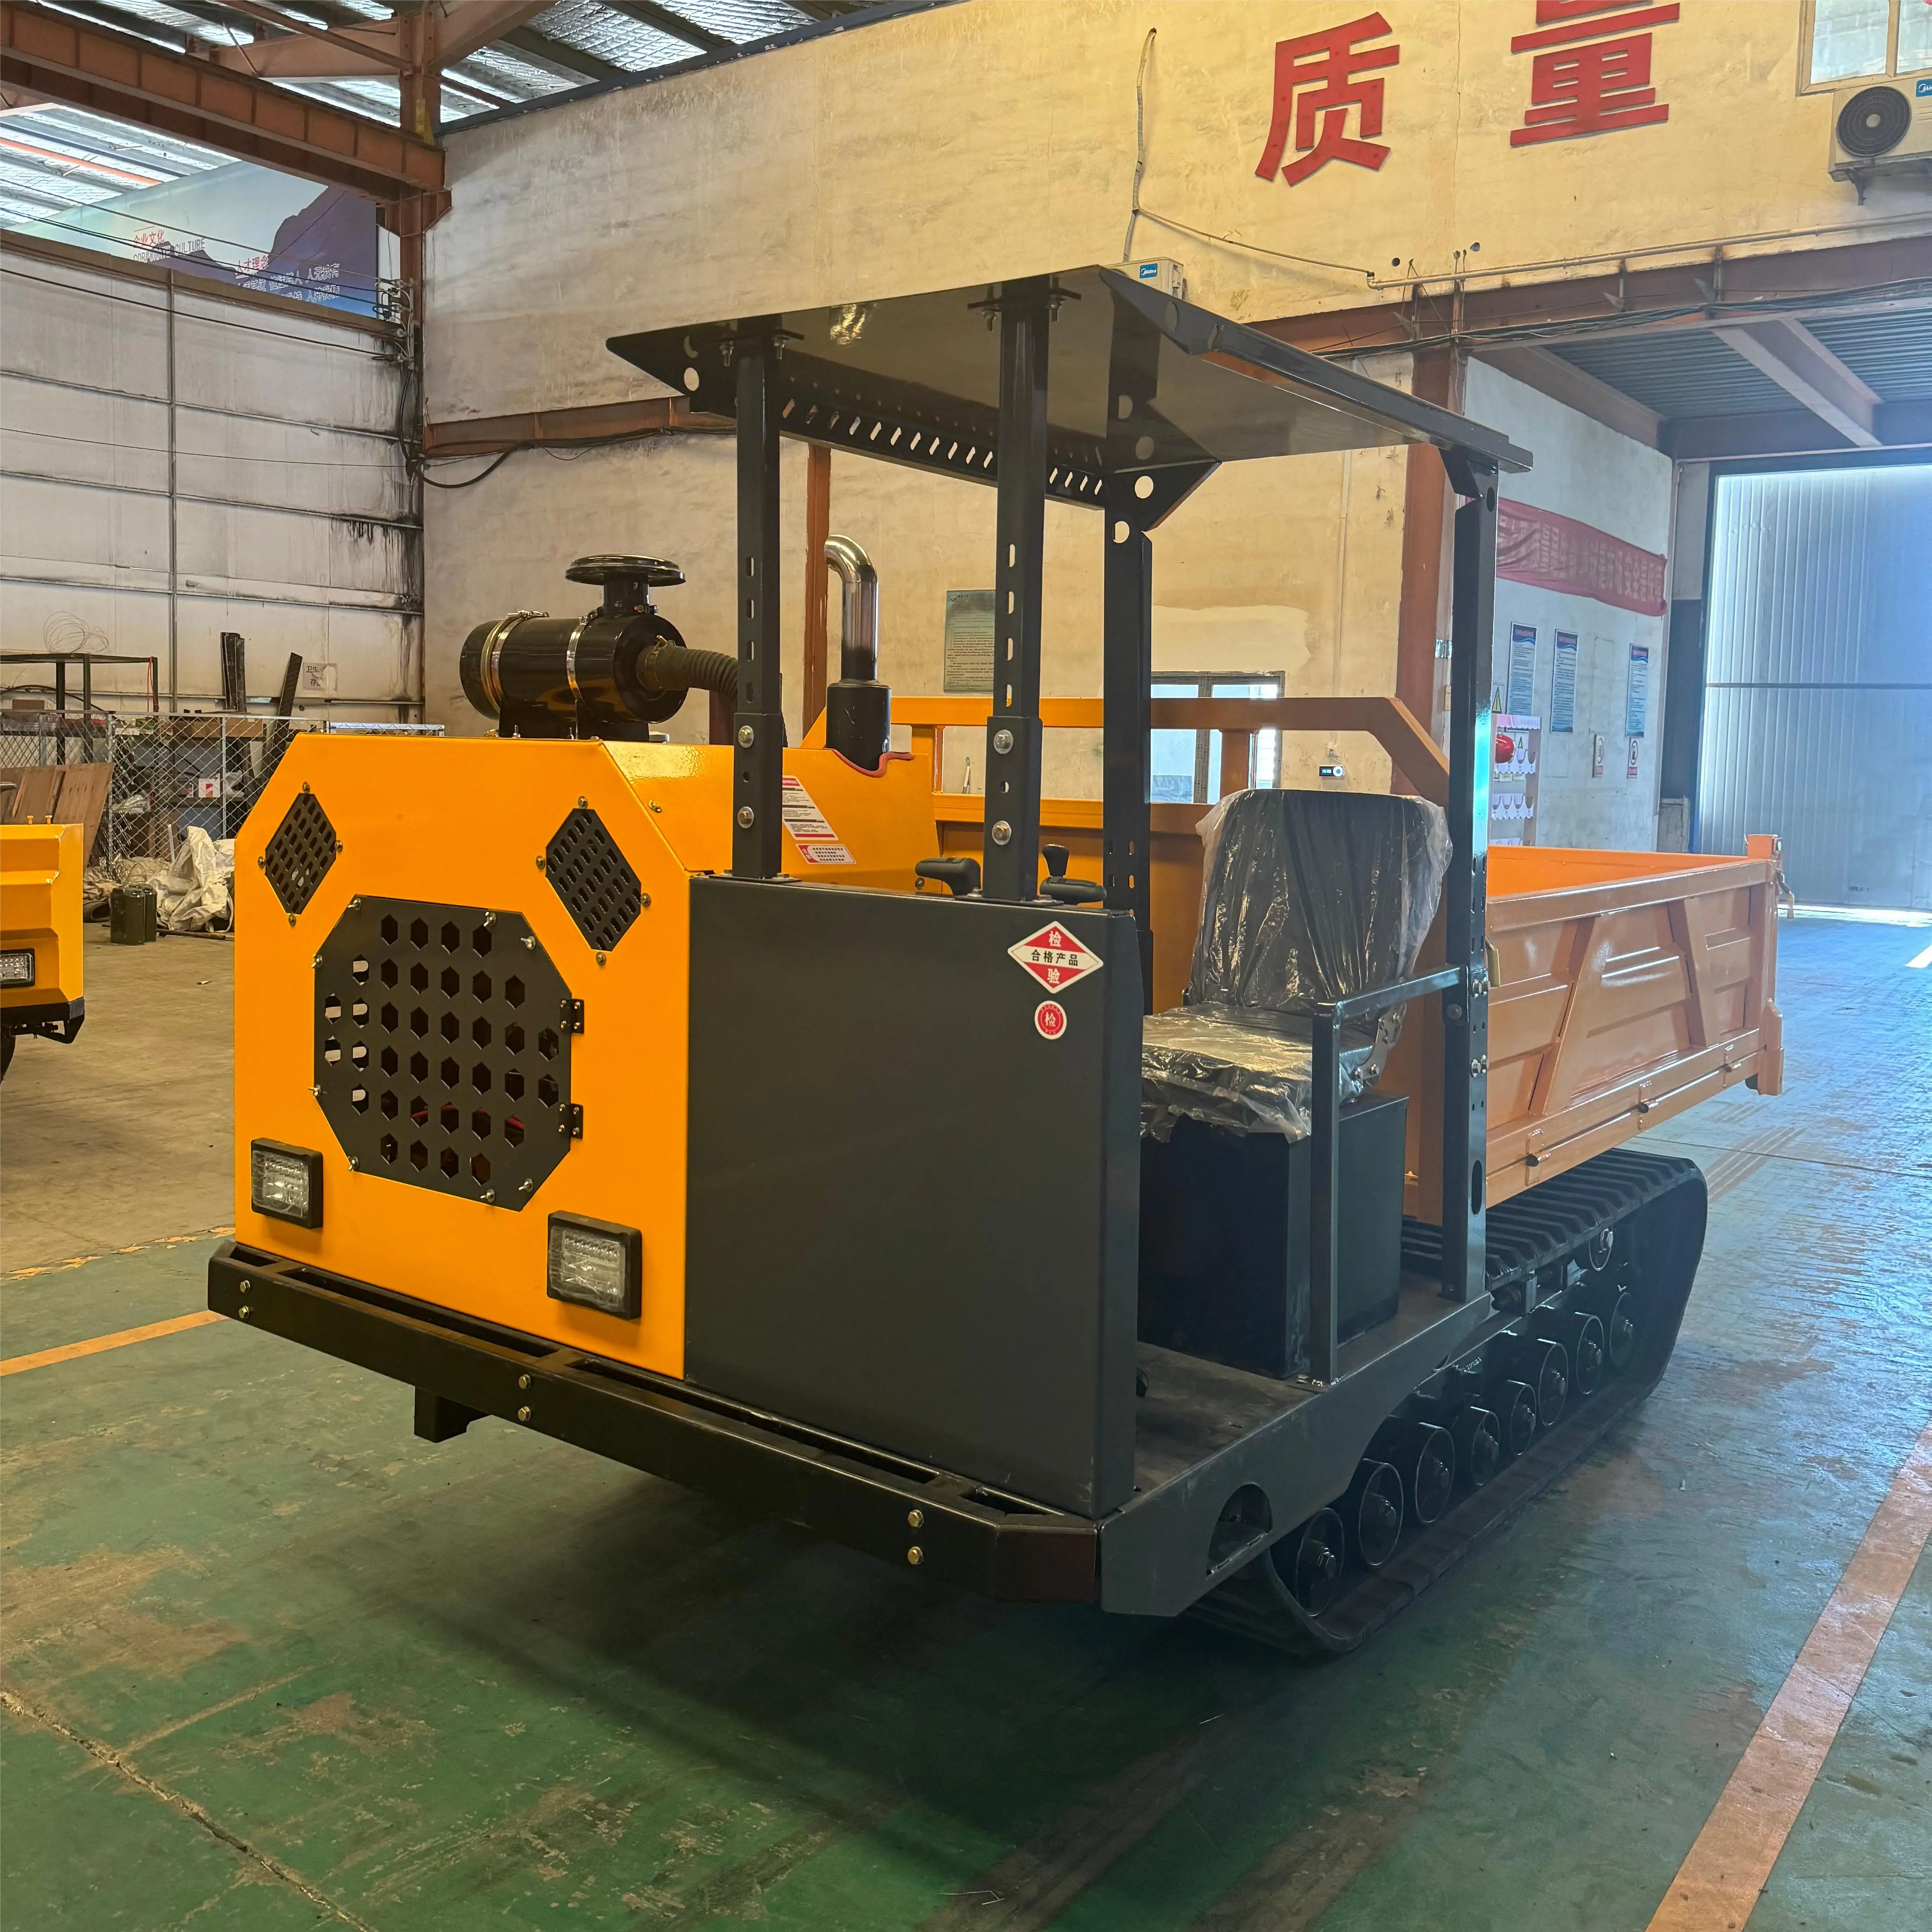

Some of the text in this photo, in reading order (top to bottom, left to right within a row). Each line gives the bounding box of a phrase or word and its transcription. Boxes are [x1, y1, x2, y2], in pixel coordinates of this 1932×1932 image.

[133, 229, 165, 247] 企业文化
[1049, 930, 1062, 947] 检
[1031, 949, 1079, 966] 合格产品
[1047, 968, 1060, 984] 验
[1044, 1012, 1056, 1027] 检
